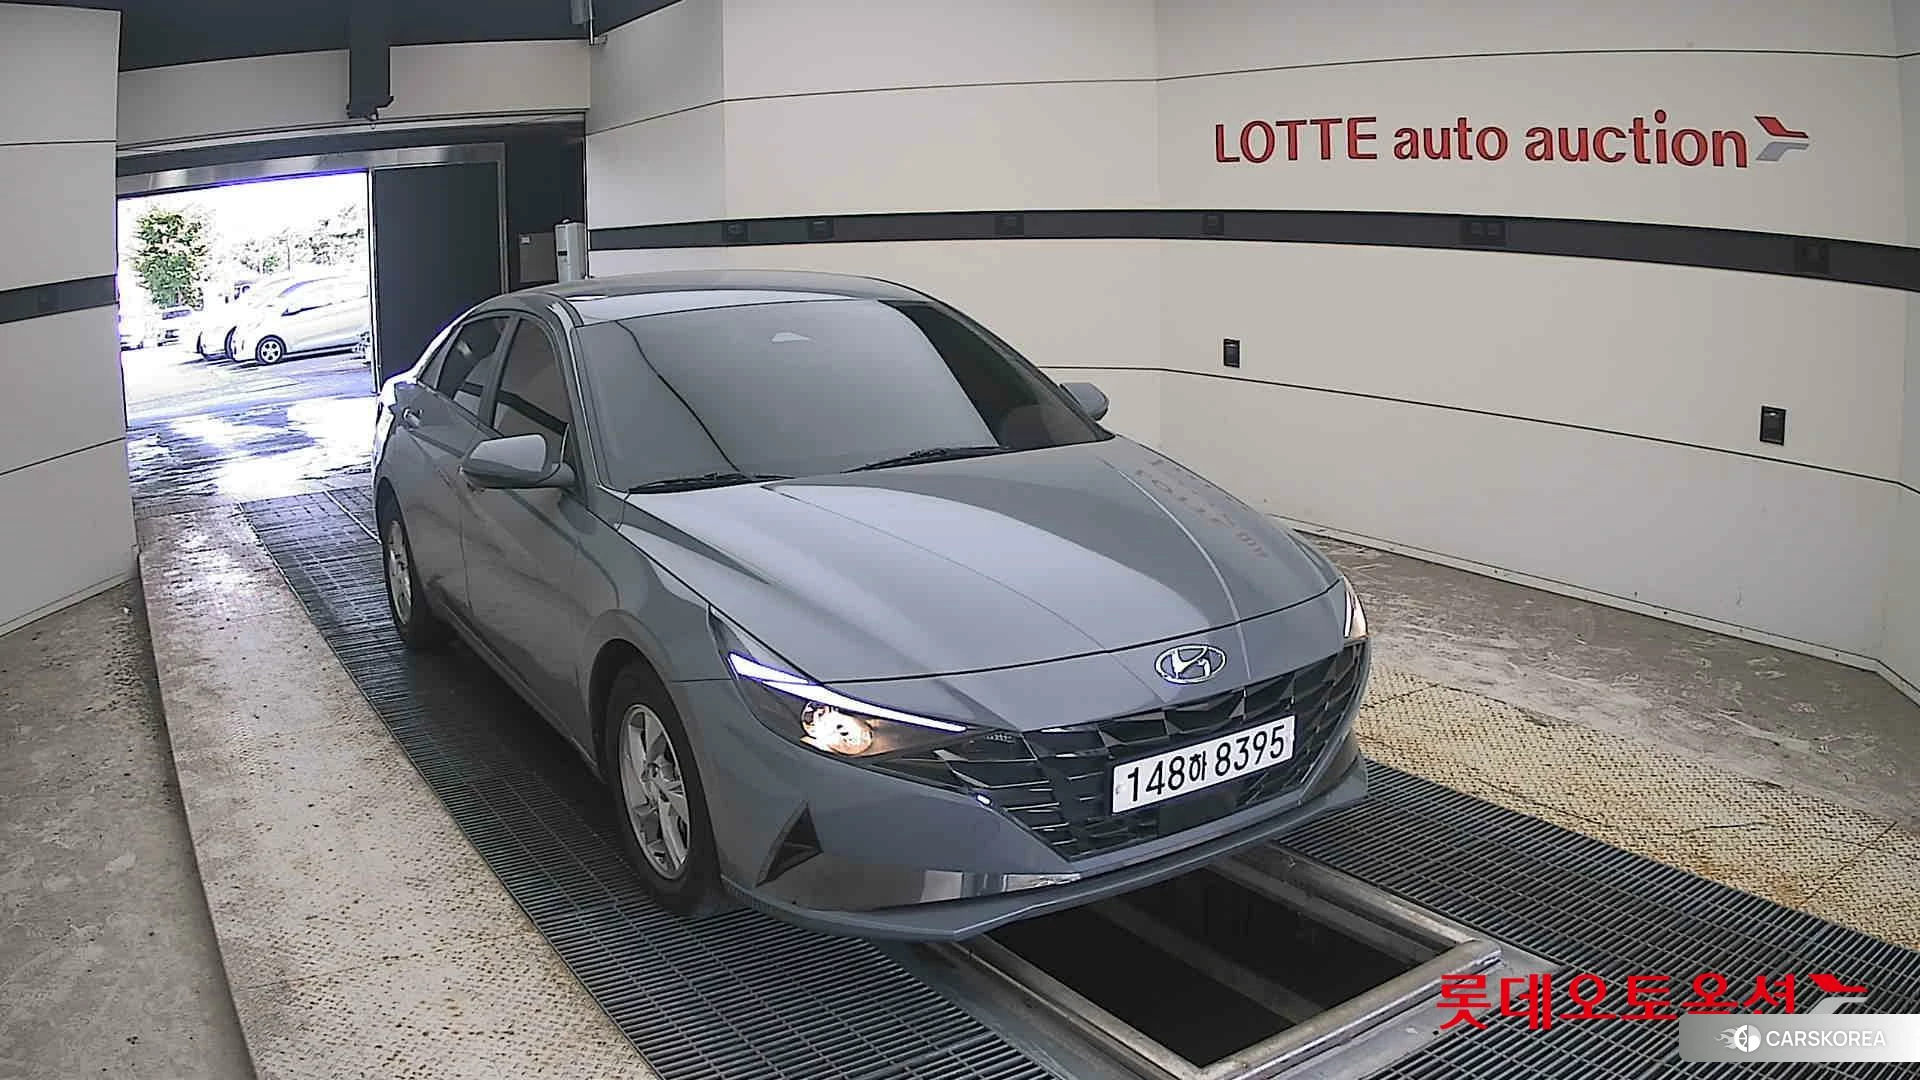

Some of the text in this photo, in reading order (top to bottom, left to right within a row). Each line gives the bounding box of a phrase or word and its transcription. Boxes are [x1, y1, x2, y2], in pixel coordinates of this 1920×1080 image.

[1215, 109, 1748, 168] LOTTE auto auction
[1128, 725, 1285, 801] 148하 8395
